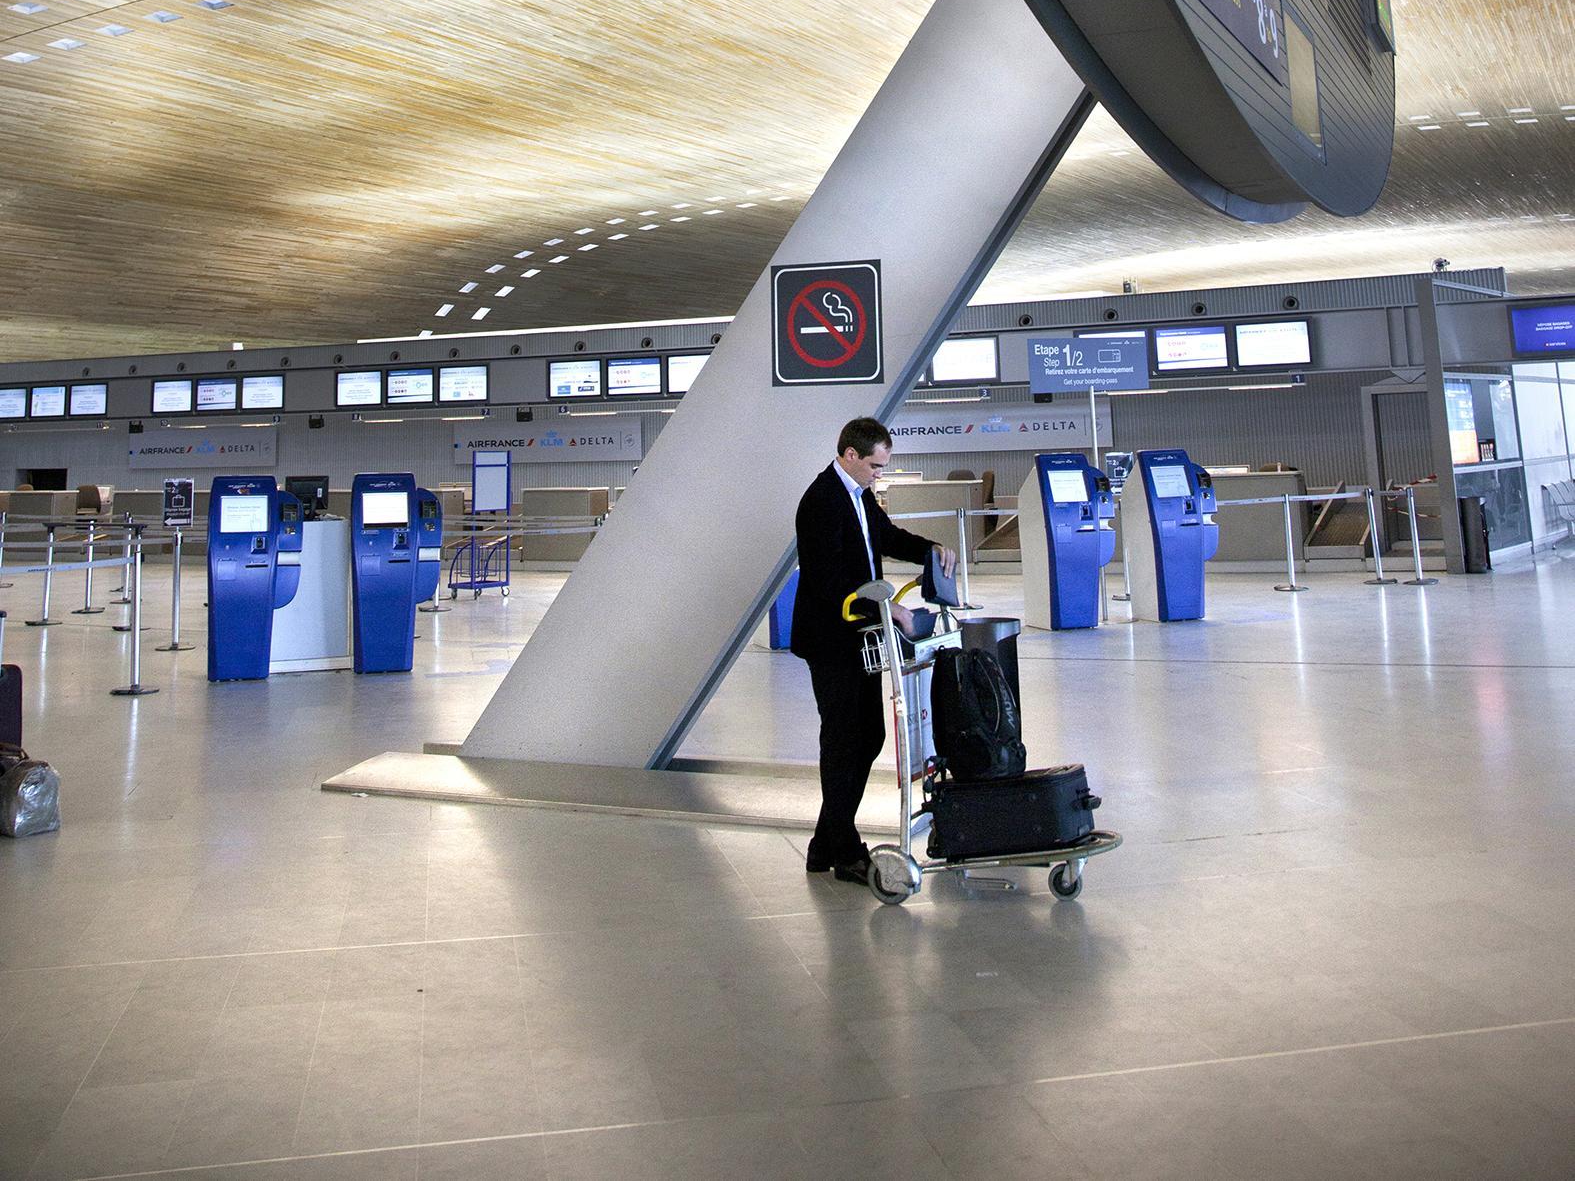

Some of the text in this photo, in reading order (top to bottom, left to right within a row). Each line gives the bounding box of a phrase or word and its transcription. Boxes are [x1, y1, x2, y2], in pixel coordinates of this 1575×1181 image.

[1270, 8, 1279, 59] 9
[1034, 343, 1083, 367] Etape 1/2
[1043, 357, 1060, 368] Step
[1092, 366, 1134, 375] d'embarquement
[1063, 378, 1073, 386] Get
[1073, 379, 1085, 387] your
[981, 389, 987, 397] 3
[889, 425, 962, 436] AIRFRANCE
[1033, 421, 1077, 431] DELTA
[467, 439, 525, 449] AIRFRANCE
[580, 436, 615, 445] DELTA
[139, 446, 185, 455] AIRFRANCE
[228, 444, 255, 452] DELTA
